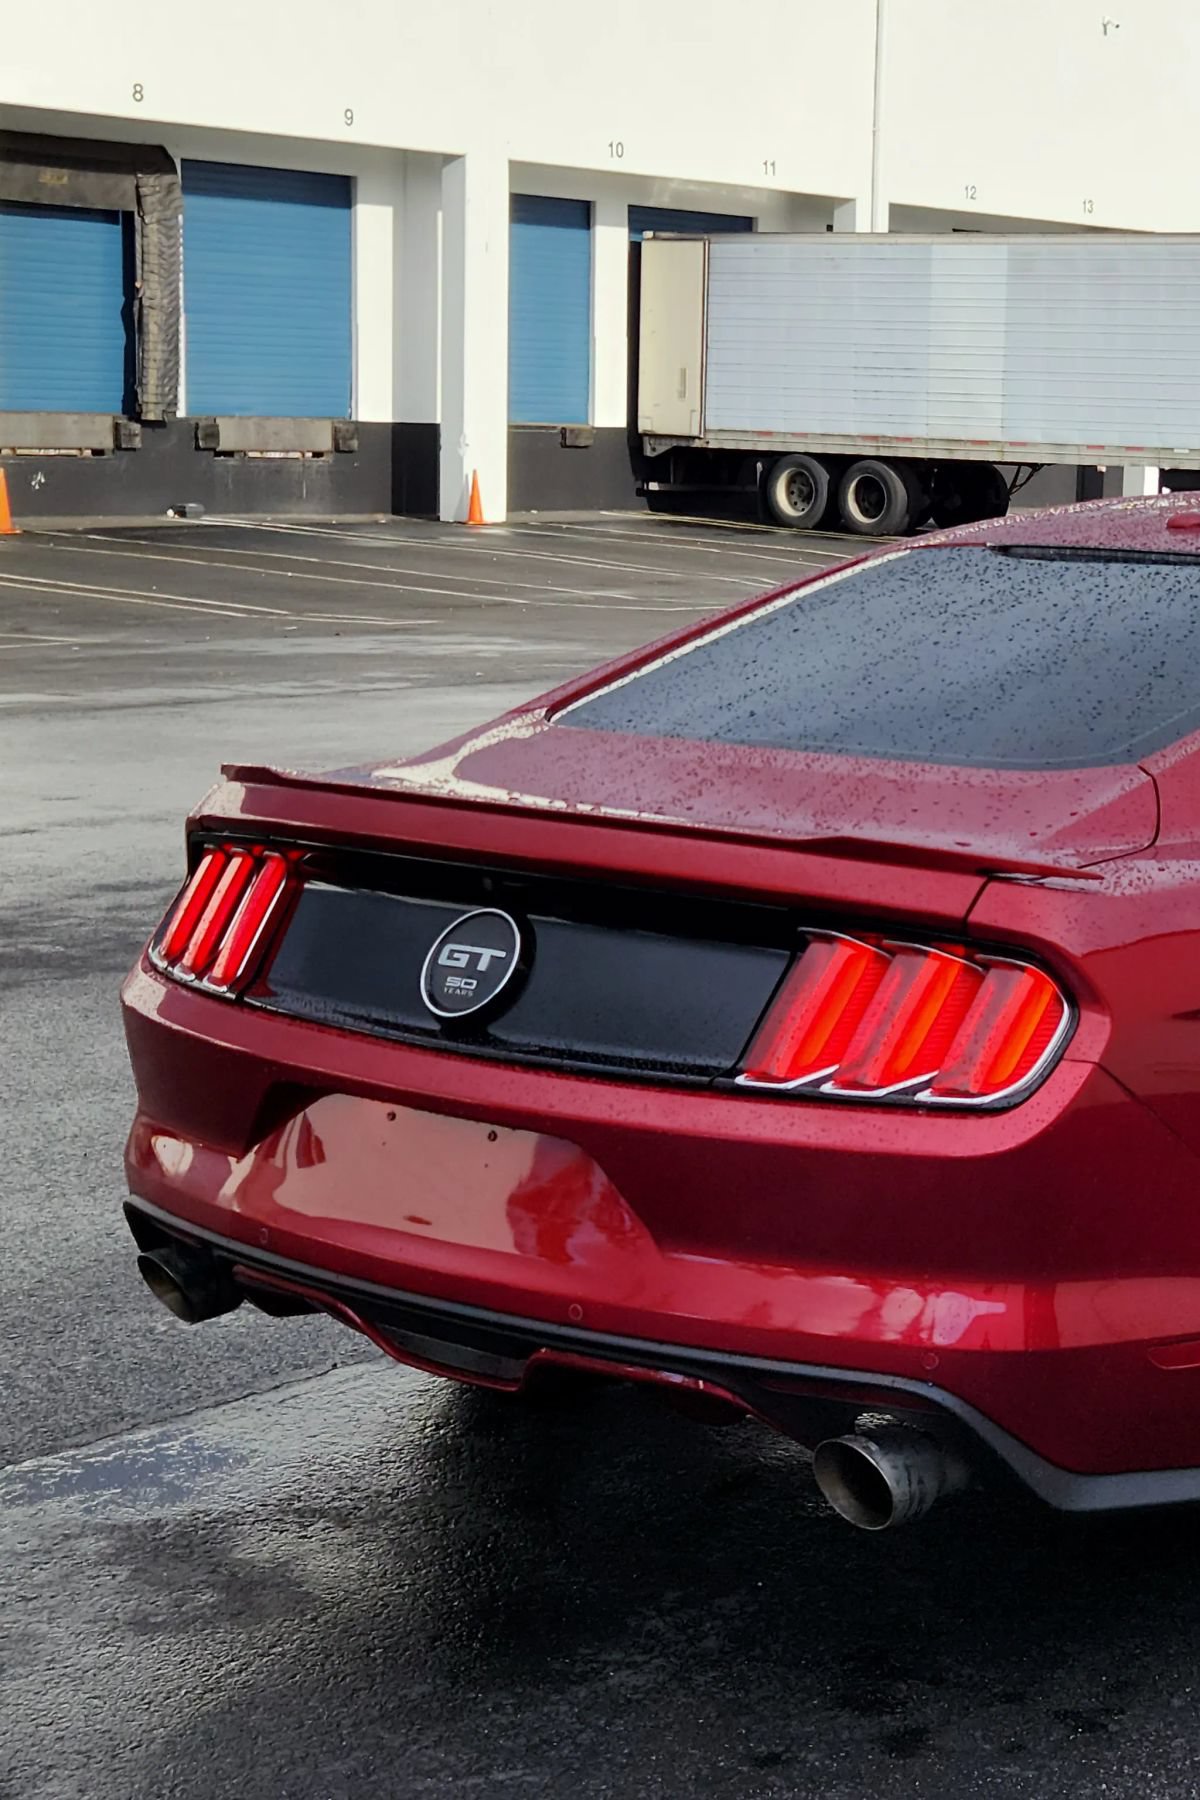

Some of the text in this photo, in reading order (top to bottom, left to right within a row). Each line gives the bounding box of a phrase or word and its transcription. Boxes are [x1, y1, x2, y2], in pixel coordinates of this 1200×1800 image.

[132, 83, 144, 103] 8
[344, 109, 354, 126] 9
[608, 142, 625, 159] 10
[762, 160, 776, 177] 11
[964, 185, 977, 200] 12
[1082, 199, 1094, 214] 13
[438, 943, 507, 972] GT
[446, 976, 477, 990] 50
[444, 987, 473, 997] YEARS
